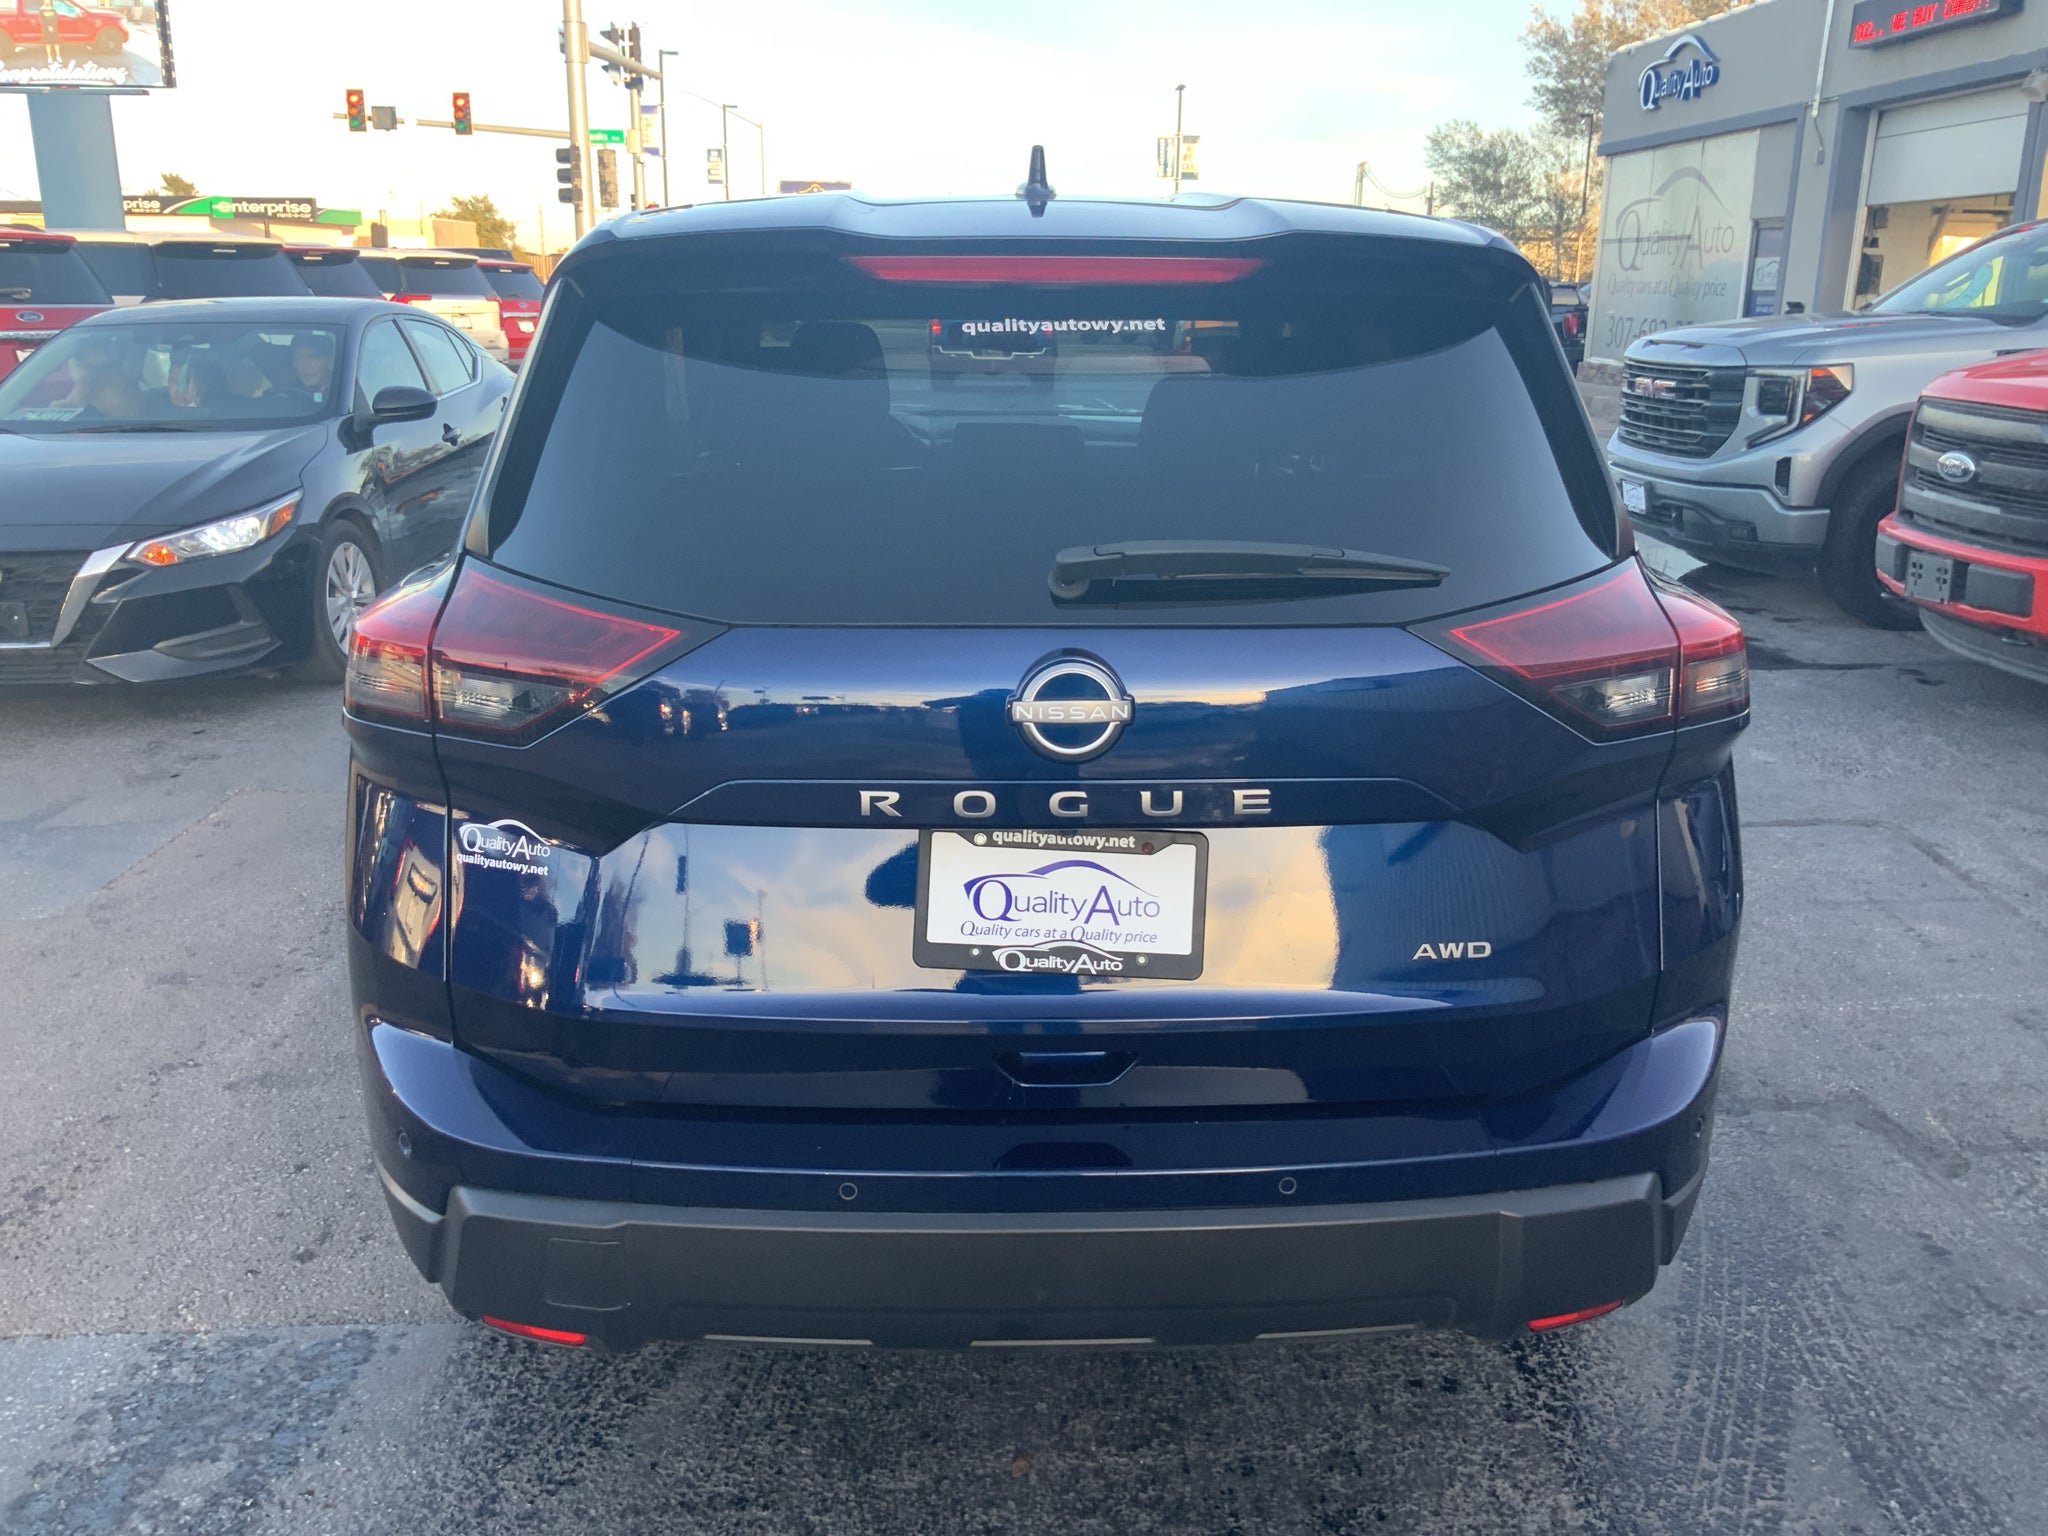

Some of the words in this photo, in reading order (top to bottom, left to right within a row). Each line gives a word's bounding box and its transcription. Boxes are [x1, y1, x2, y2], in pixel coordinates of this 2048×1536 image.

[1911, 3, 1938, 26] BUY
[0, 59, 129, 85] ongratulations
[122, 197, 161, 211] prise
[212, 200, 312, 215] enterprise
[1701, 276, 1727, 301] price
[961, 318, 1166, 336] qualityautowy.net
[1016, 705, 1128, 720] NISSAN
[859, 788, 1272, 818] ROGUE
[992, 830, 1136, 849] qualityautowy.net
[456, 853, 549, 876] qualityautowy.net
[960, 920, 1012, 938] Quality
[1014, 927, 1040, 939] cars
[1043, 928, 1058, 940] at
[1060, 930, 1068, 939] a
[1070, 925, 1121, 943] Quality
[1124, 930, 1158, 944] price
[1412, 941, 1491, 960] AWD
